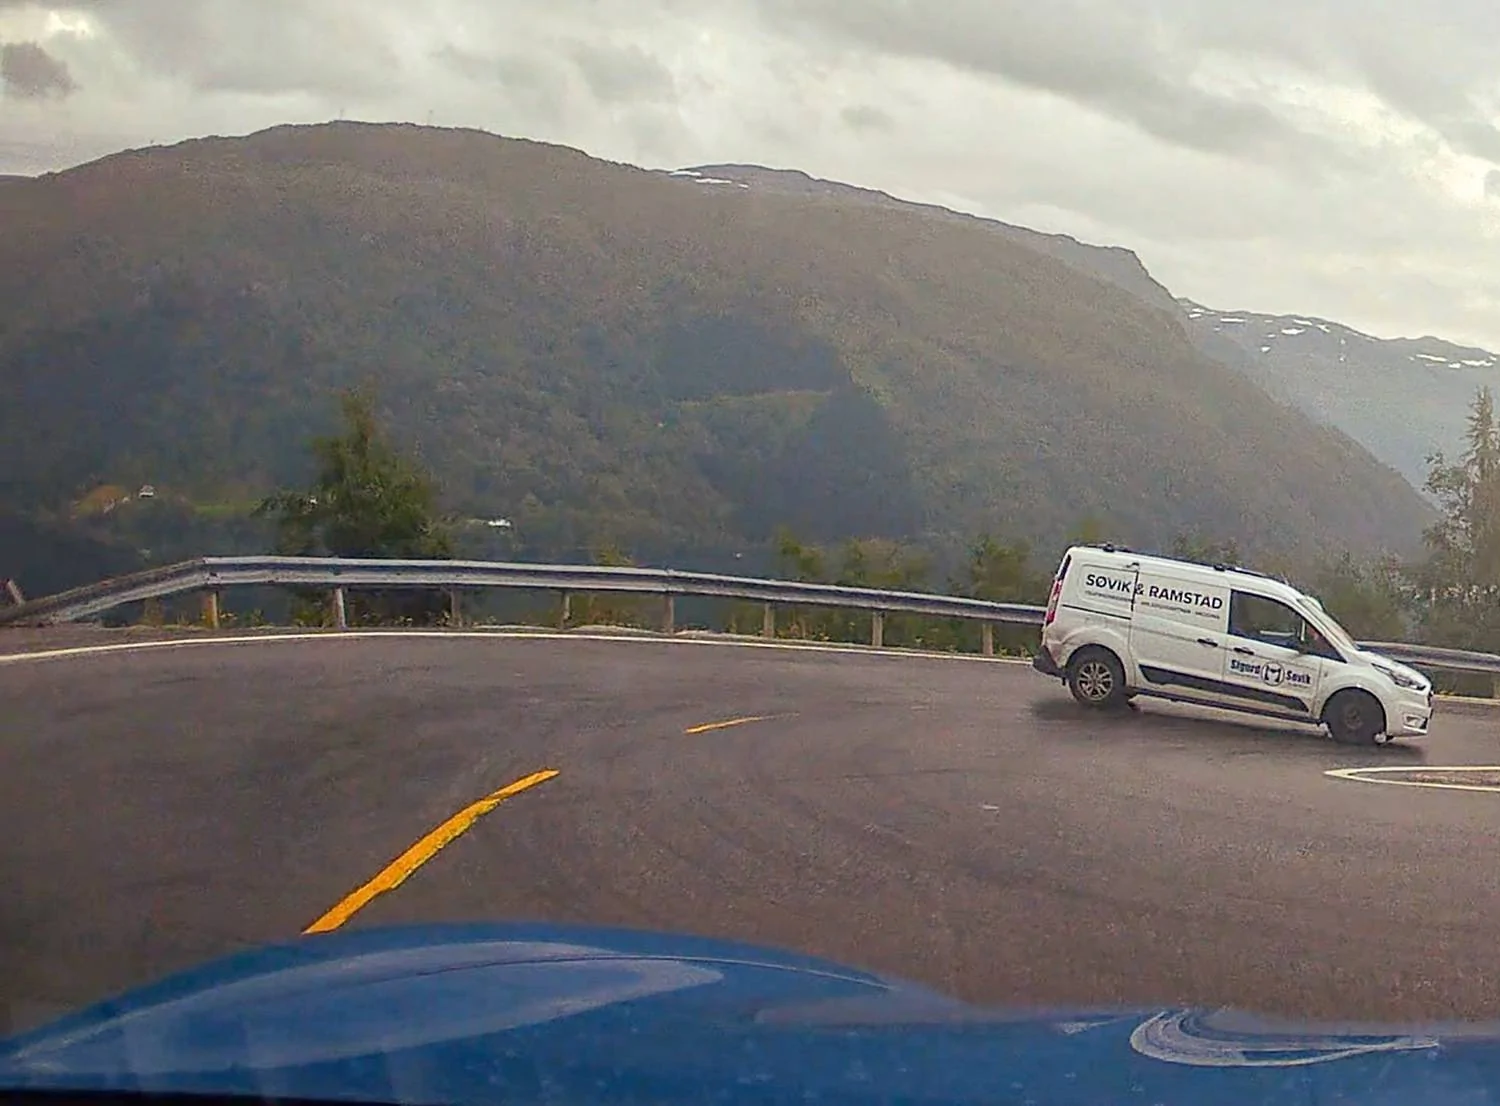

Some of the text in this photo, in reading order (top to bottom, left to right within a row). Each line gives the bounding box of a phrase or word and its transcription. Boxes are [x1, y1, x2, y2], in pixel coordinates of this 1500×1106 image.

[1085, 574, 1132, 593] SØVIK
[1135, 583, 1145, 596] &
[1148, 585, 1223, 610] RAMSTAD
[1230, 659, 1261, 674] Sigurd
